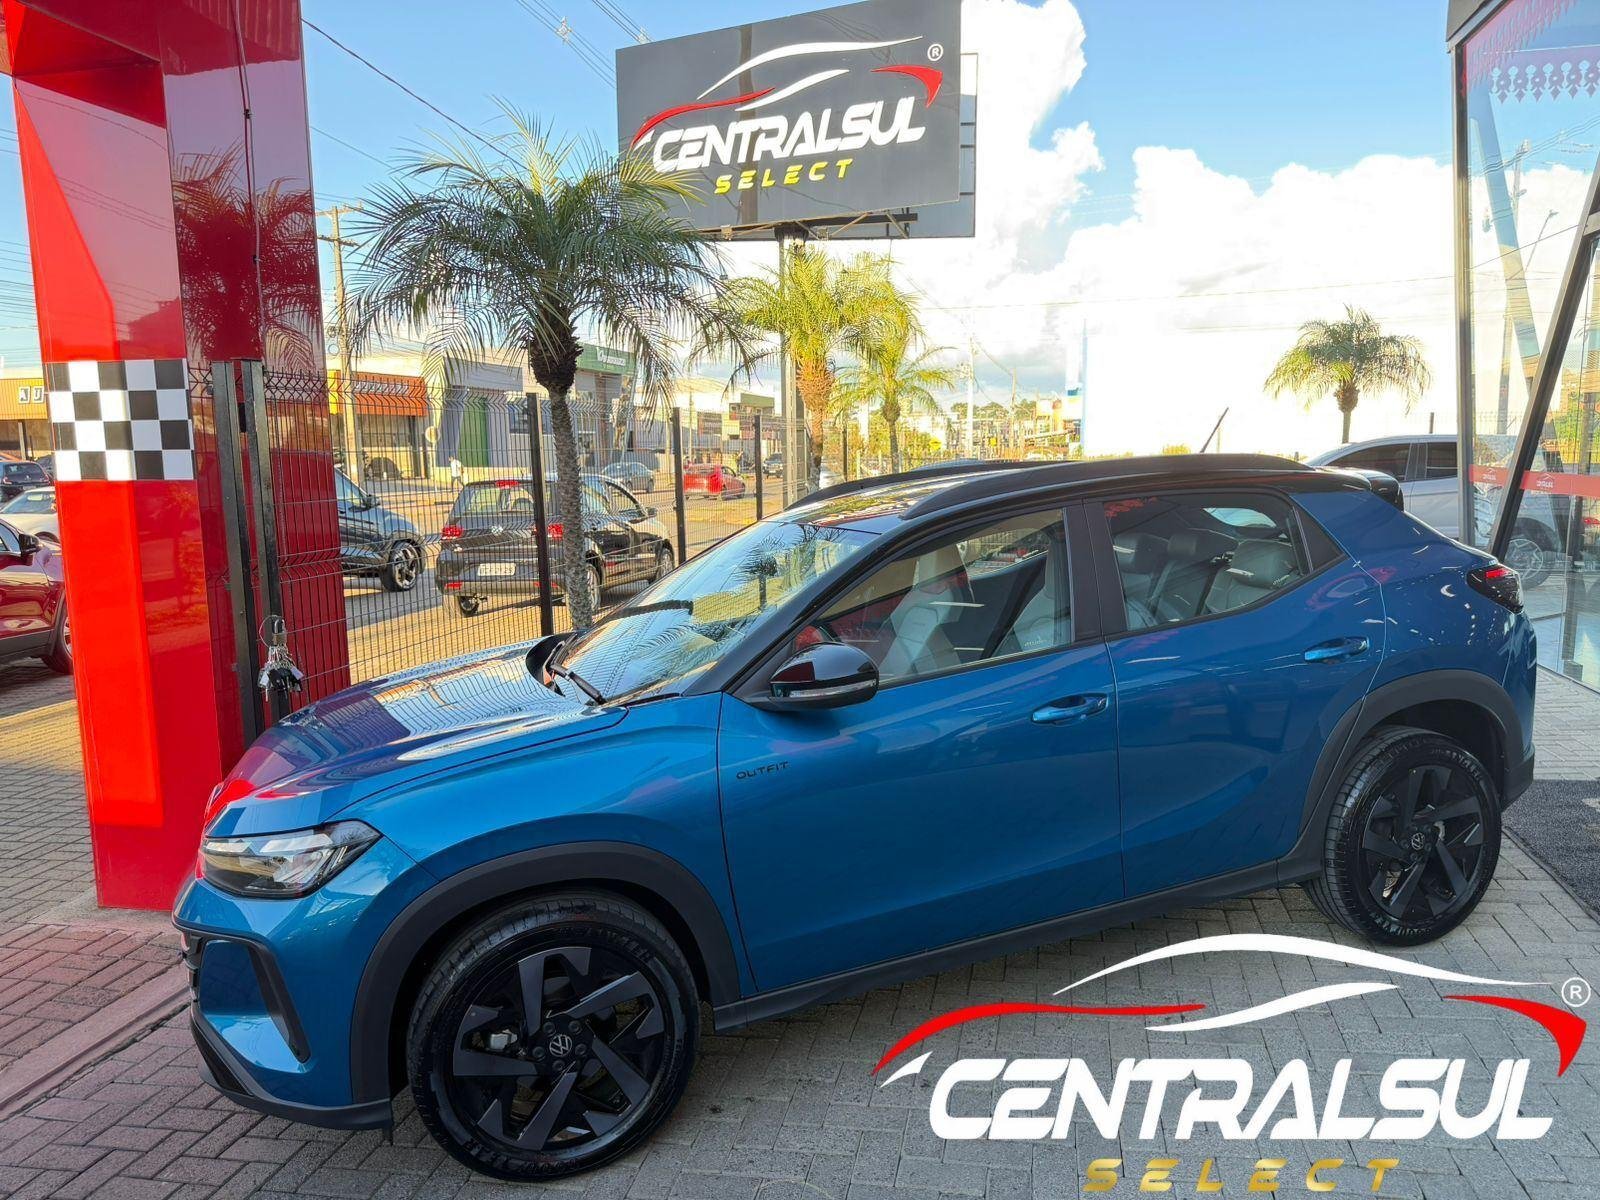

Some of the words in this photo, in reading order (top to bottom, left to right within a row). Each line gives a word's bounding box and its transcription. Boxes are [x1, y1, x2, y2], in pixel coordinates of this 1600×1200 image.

[653, 96, 926, 173] CENTRALSUL
[715, 159, 853, 195] SELECT
[736, 760, 788, 779] OUTFIT
